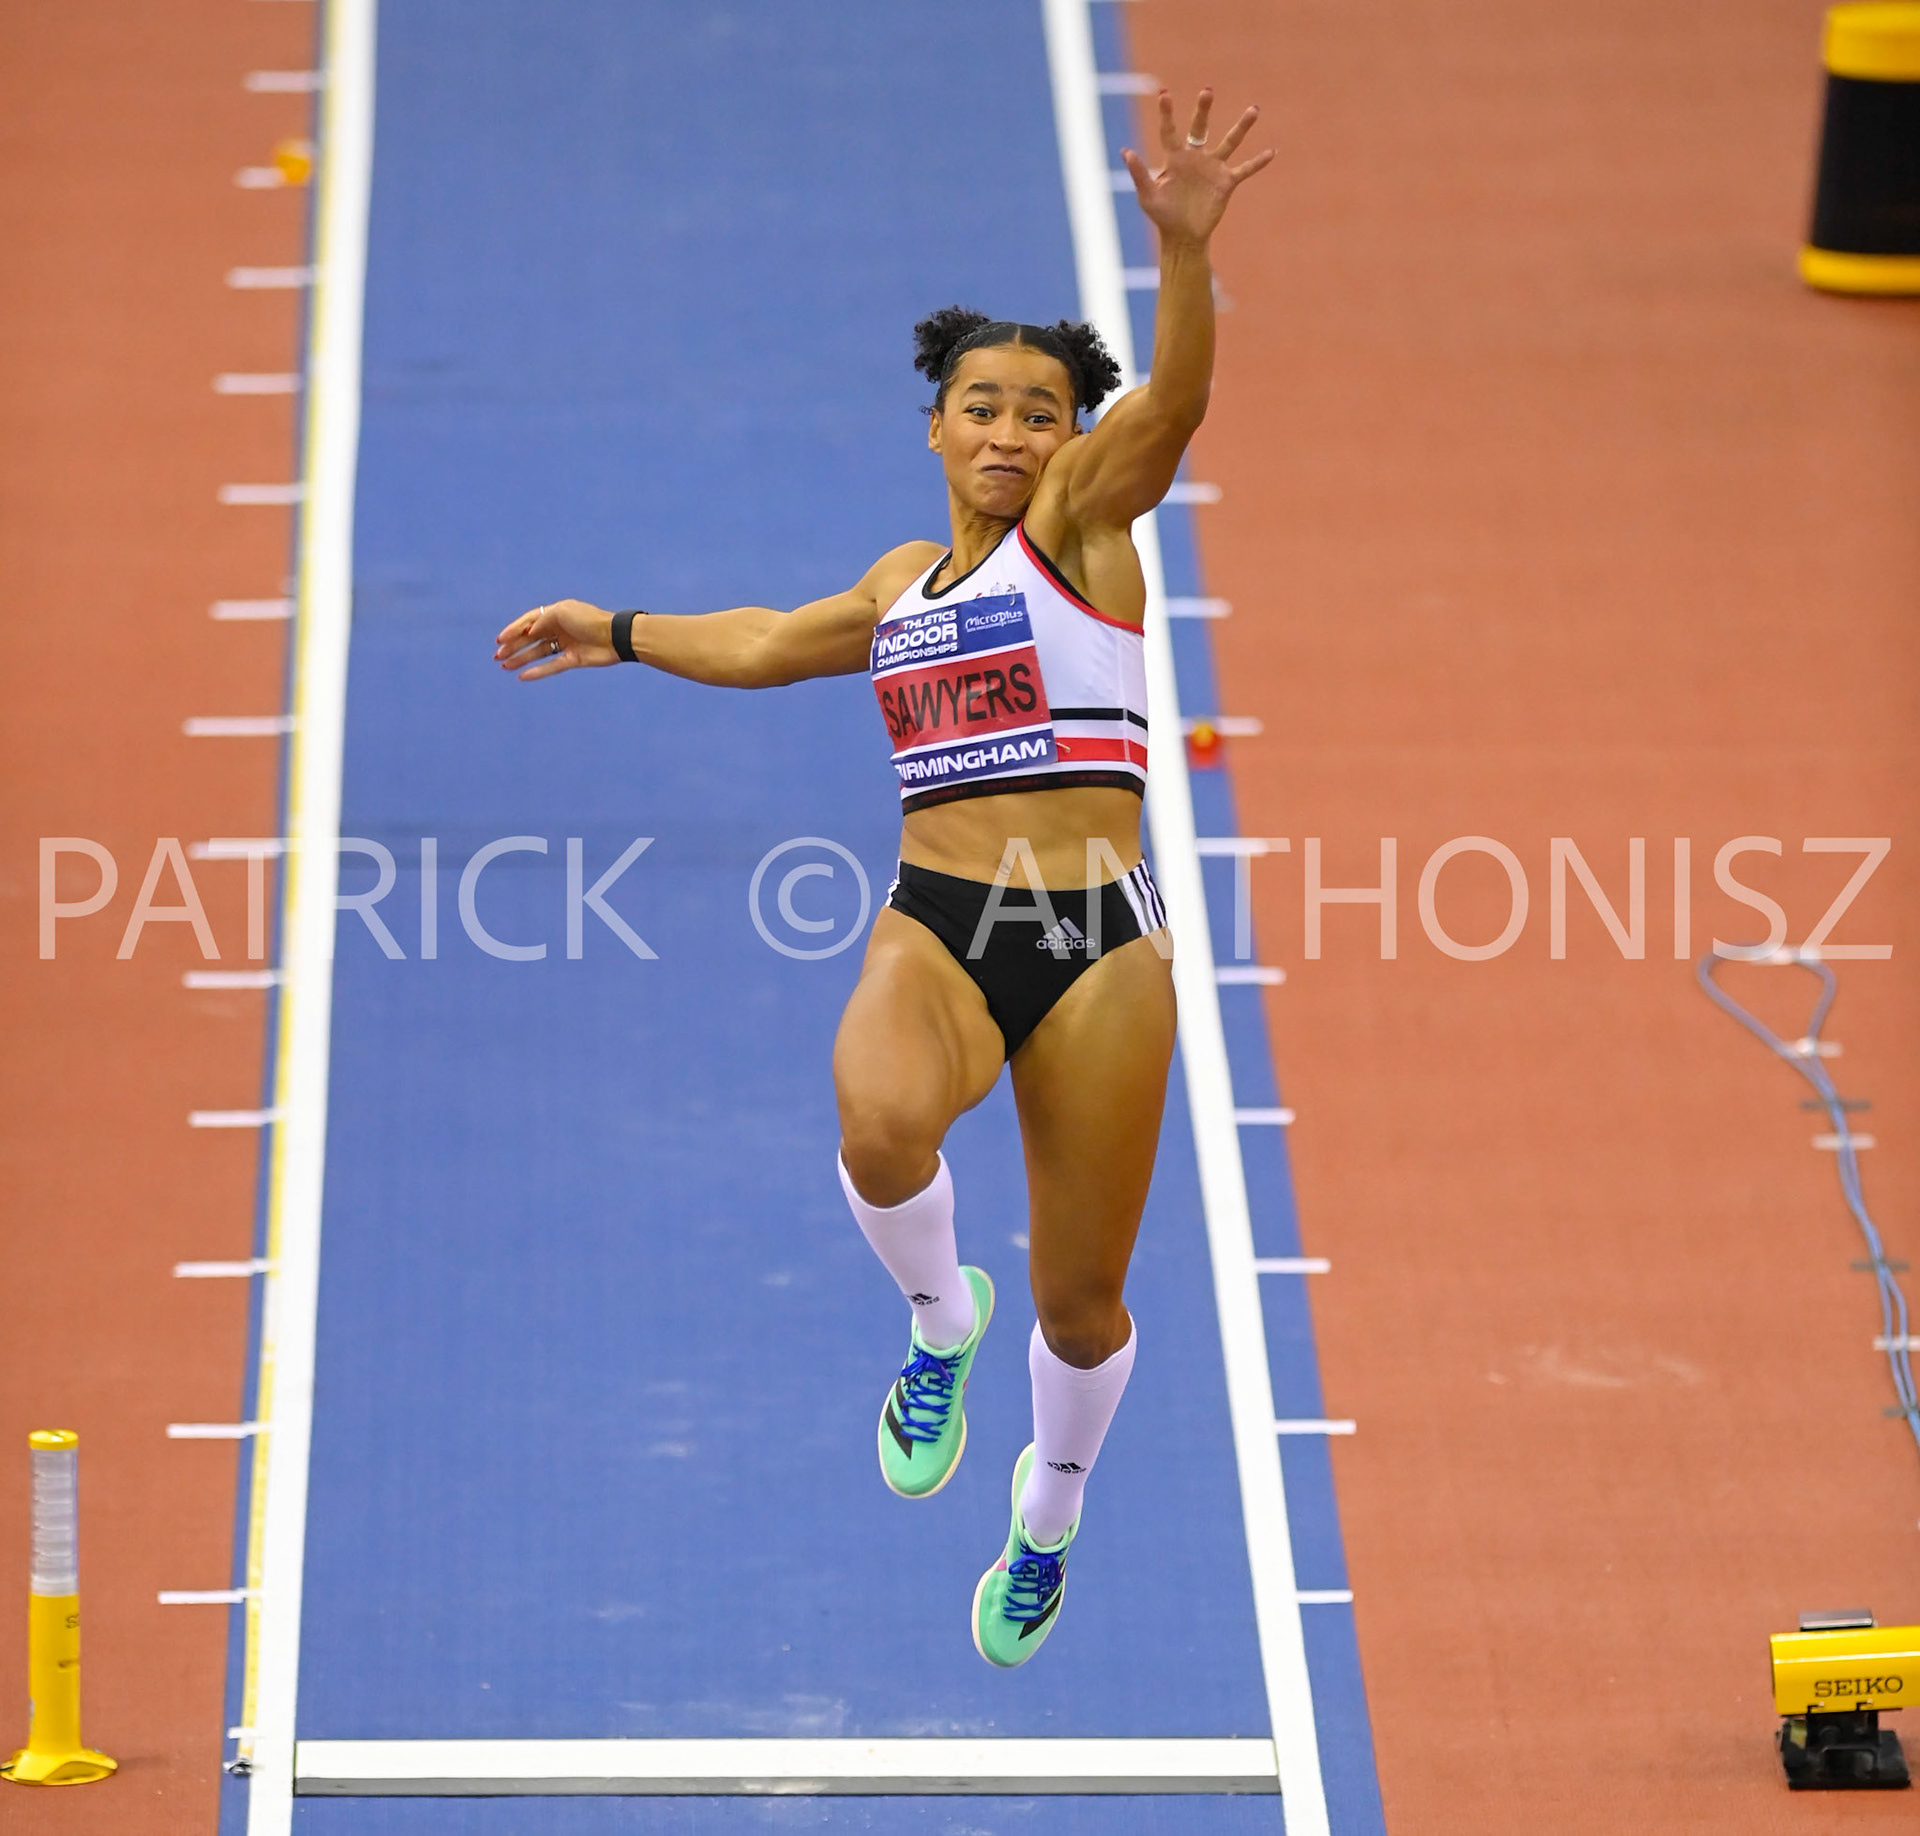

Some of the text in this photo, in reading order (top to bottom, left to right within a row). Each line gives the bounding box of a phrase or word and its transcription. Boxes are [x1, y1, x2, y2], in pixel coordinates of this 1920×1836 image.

[877, 622, 958, 658] INDOOR
[876, 642, 958, 669] CHAMPIONSHIPS
[882, 663, 1037, 738] SAWYERS
[1036, 933, 1096, 950] adidas
[1814, 1675, 1903, 1698] SEIKO
